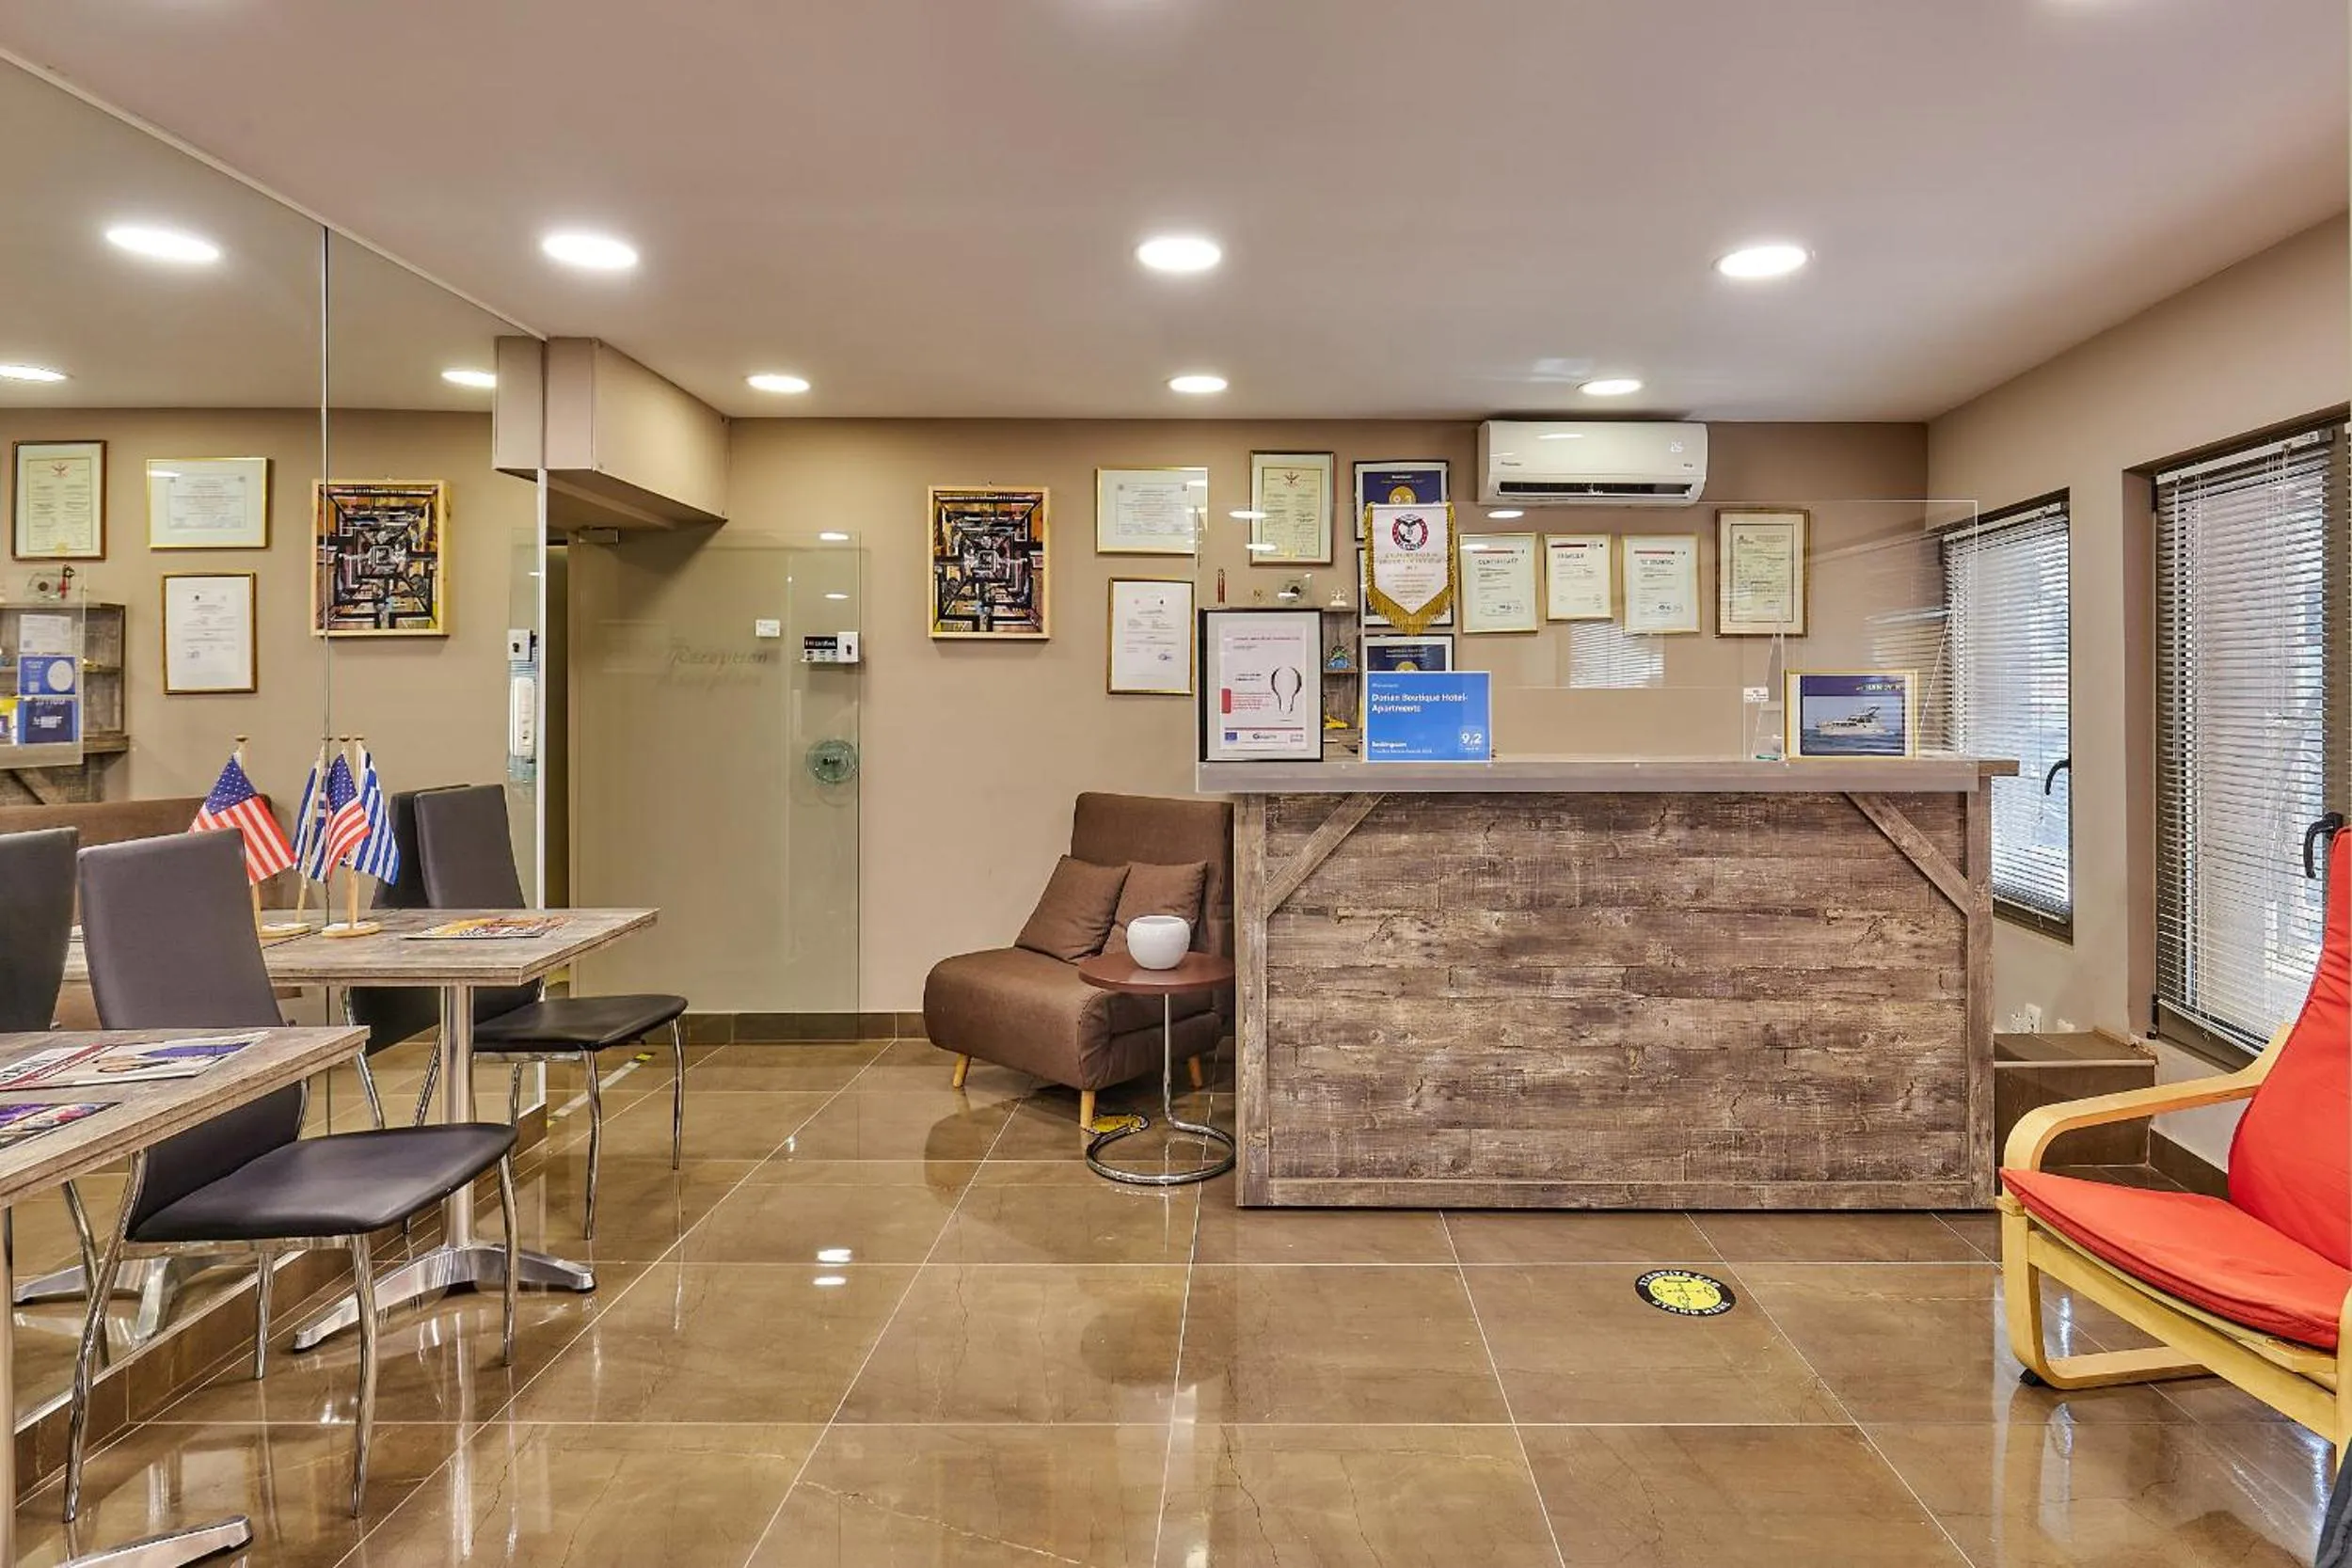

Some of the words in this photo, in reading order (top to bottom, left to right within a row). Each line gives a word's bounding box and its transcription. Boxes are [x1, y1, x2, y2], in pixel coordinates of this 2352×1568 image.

[1371, 693, 1401, 703] Dorian
[1402, 693, 1440, 704] Boutique
[1371, 705, 1422, 715] Apartments
